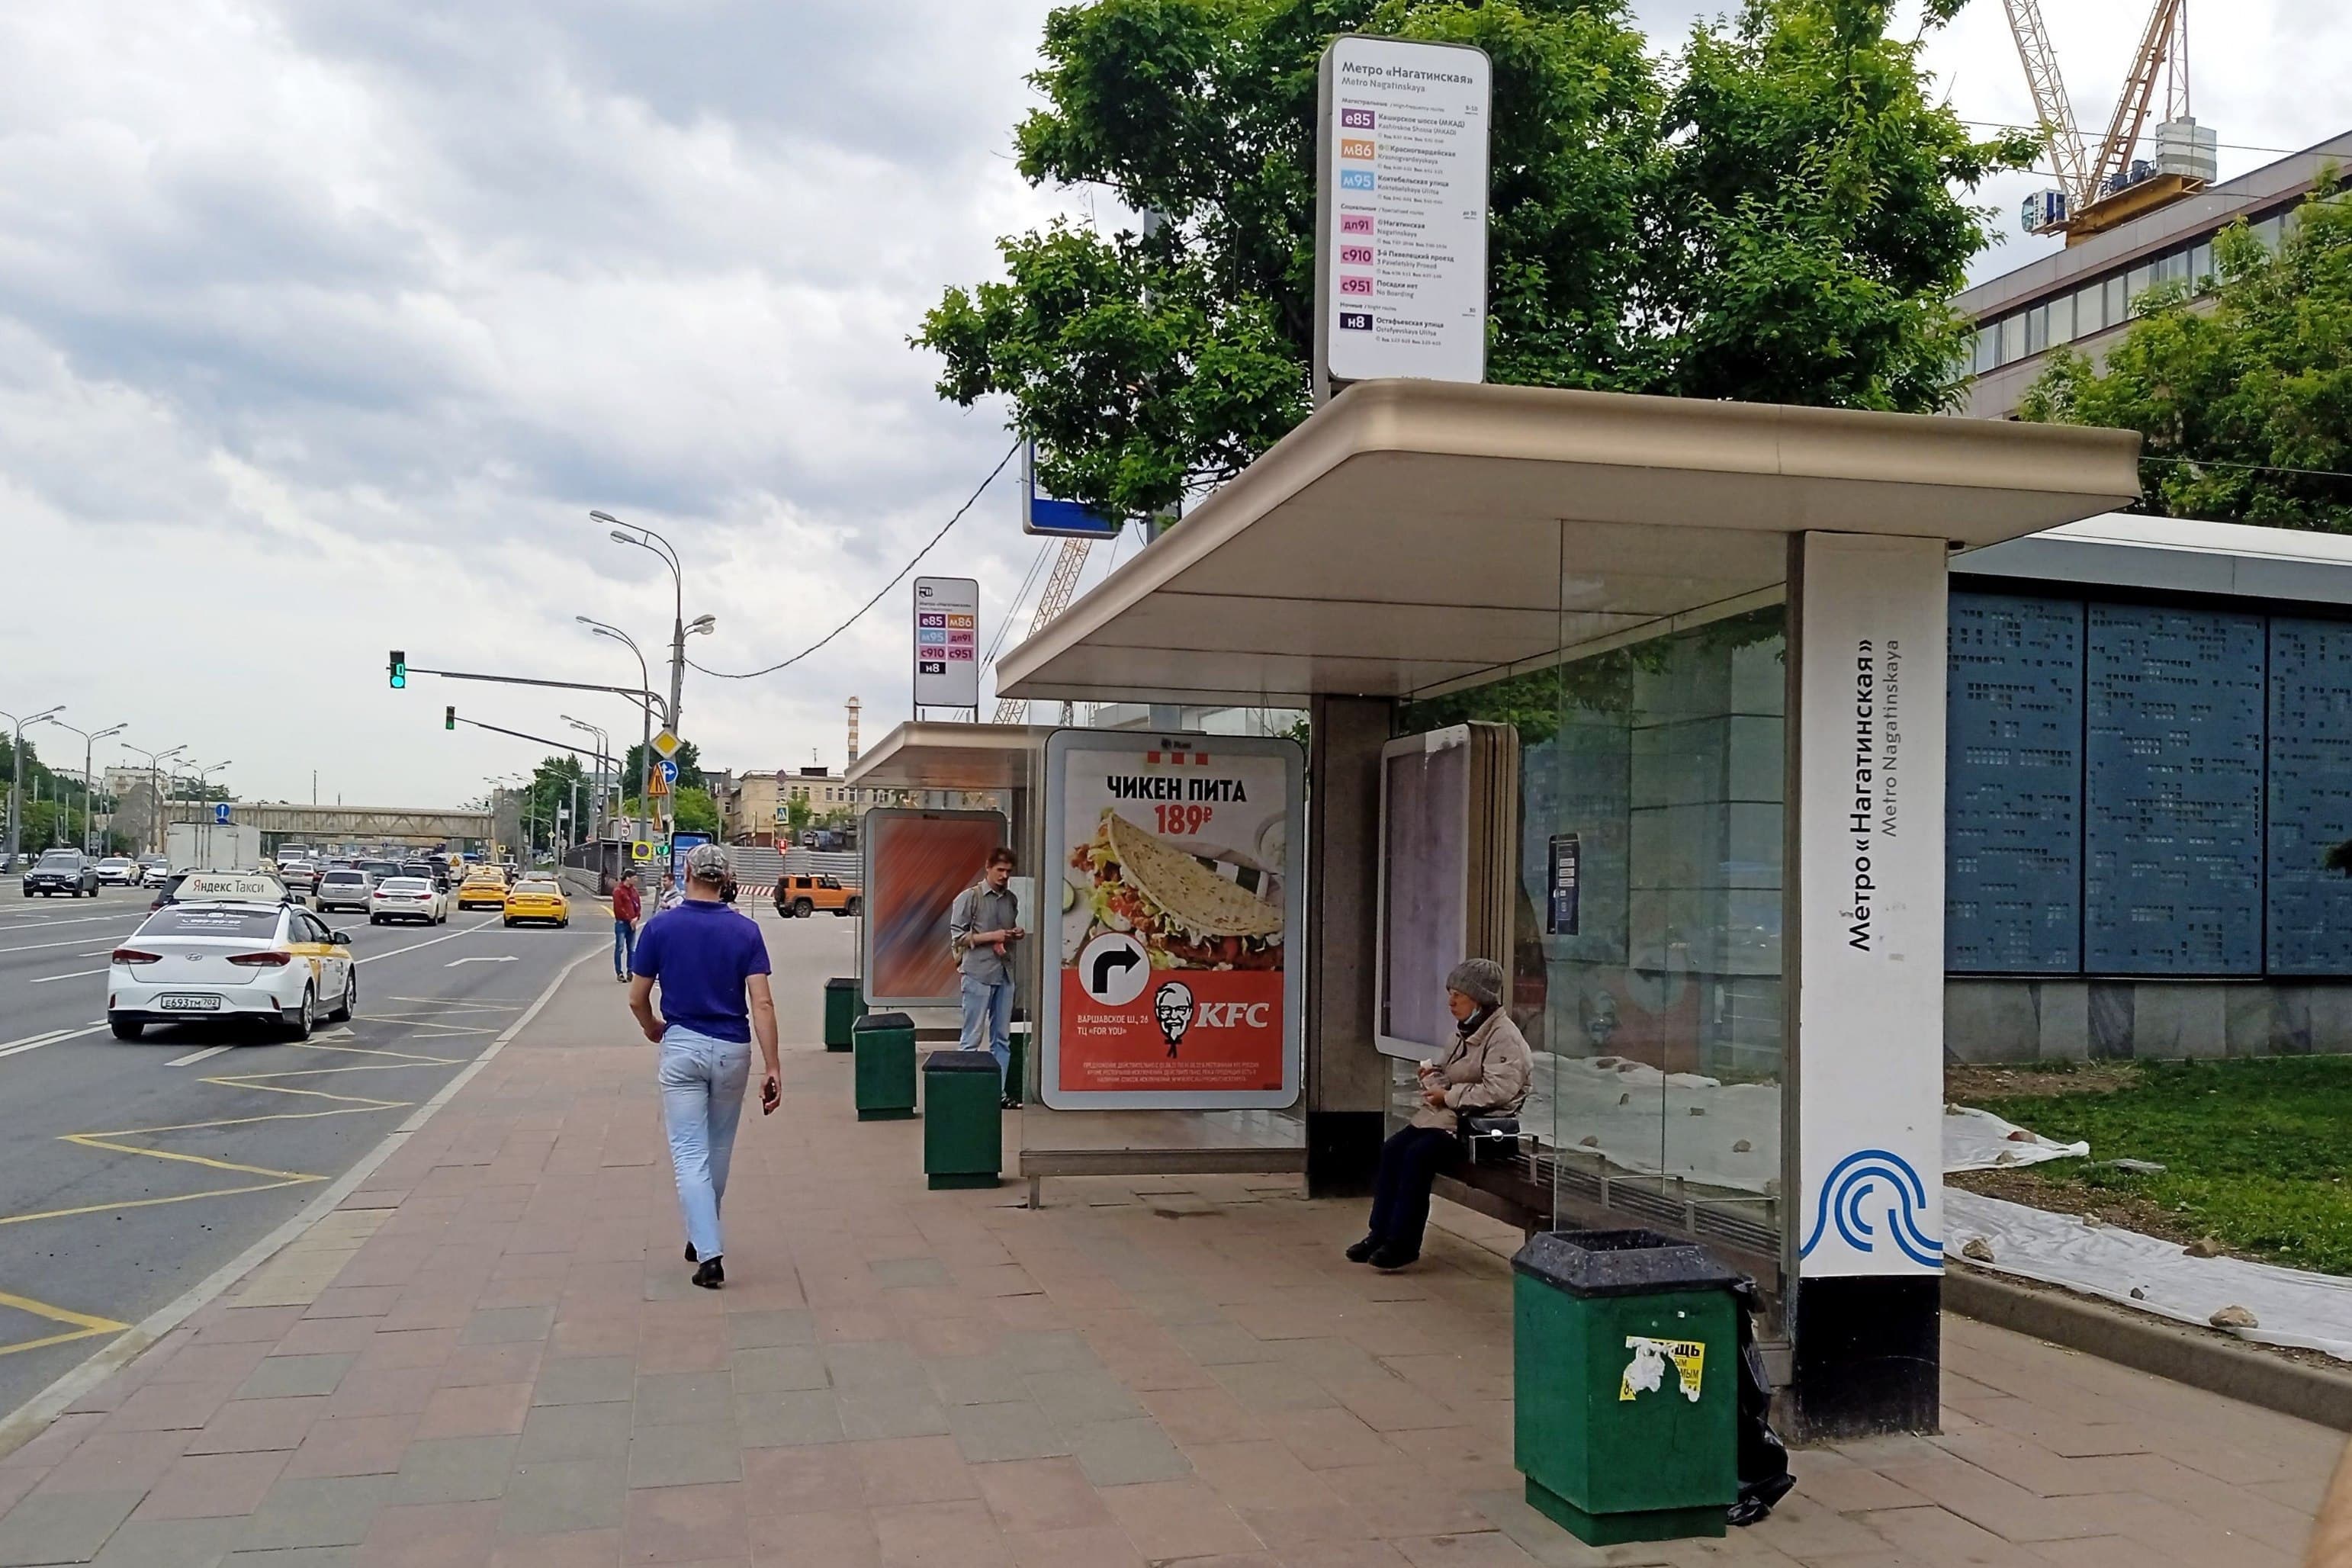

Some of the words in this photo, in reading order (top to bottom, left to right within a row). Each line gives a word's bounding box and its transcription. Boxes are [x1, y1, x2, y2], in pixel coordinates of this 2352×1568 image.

[1341, 61, 1383, 76] Метро
[1385, 66, 1473, 85] «Нагатинская»
[1341, 77, 1368, 86] Metro
[1370, 79, 1425, 93] Nagatinskaya
[1345, 113, 1370, 126] е85
[1344, 144, 1372, 157] м86
[1343, 174, 1371, 188] м95
[1344, 220, 1369, 230] дп91
[1342, 249, 1371, 262] с910
[1341, 280, 1370, 293] с951
[1377, 280, 1406, 288] Посадки
[1348, 316, 1365, 328] н8
[922, 615, 943, 626] е85
[949, 617, 972, 627] м86
[921, 647, 945, 658] с910
[949, 649, 972, 659] с951
[925, 664, 940, 673] н8
[1881, 639, 1901, 770] Nagatinskaya
[1107, 776, 1182, 800] ЧИКЕН
[1188, 779, 1247, 802] ПИТА
[1881, 776, 1898, 837] Metro
[193, 879, 232, 893] Яндекс
[235, 880, 265, 893] Такси
[1848, 854, 1876, 953] Метро
[1077, 1014, 1126, 1023] ВАРШАВСКОЕ
[1194, 1002, 1270, 1028] KFC
[1077, 1027, 1088, 1036] ТЦ
